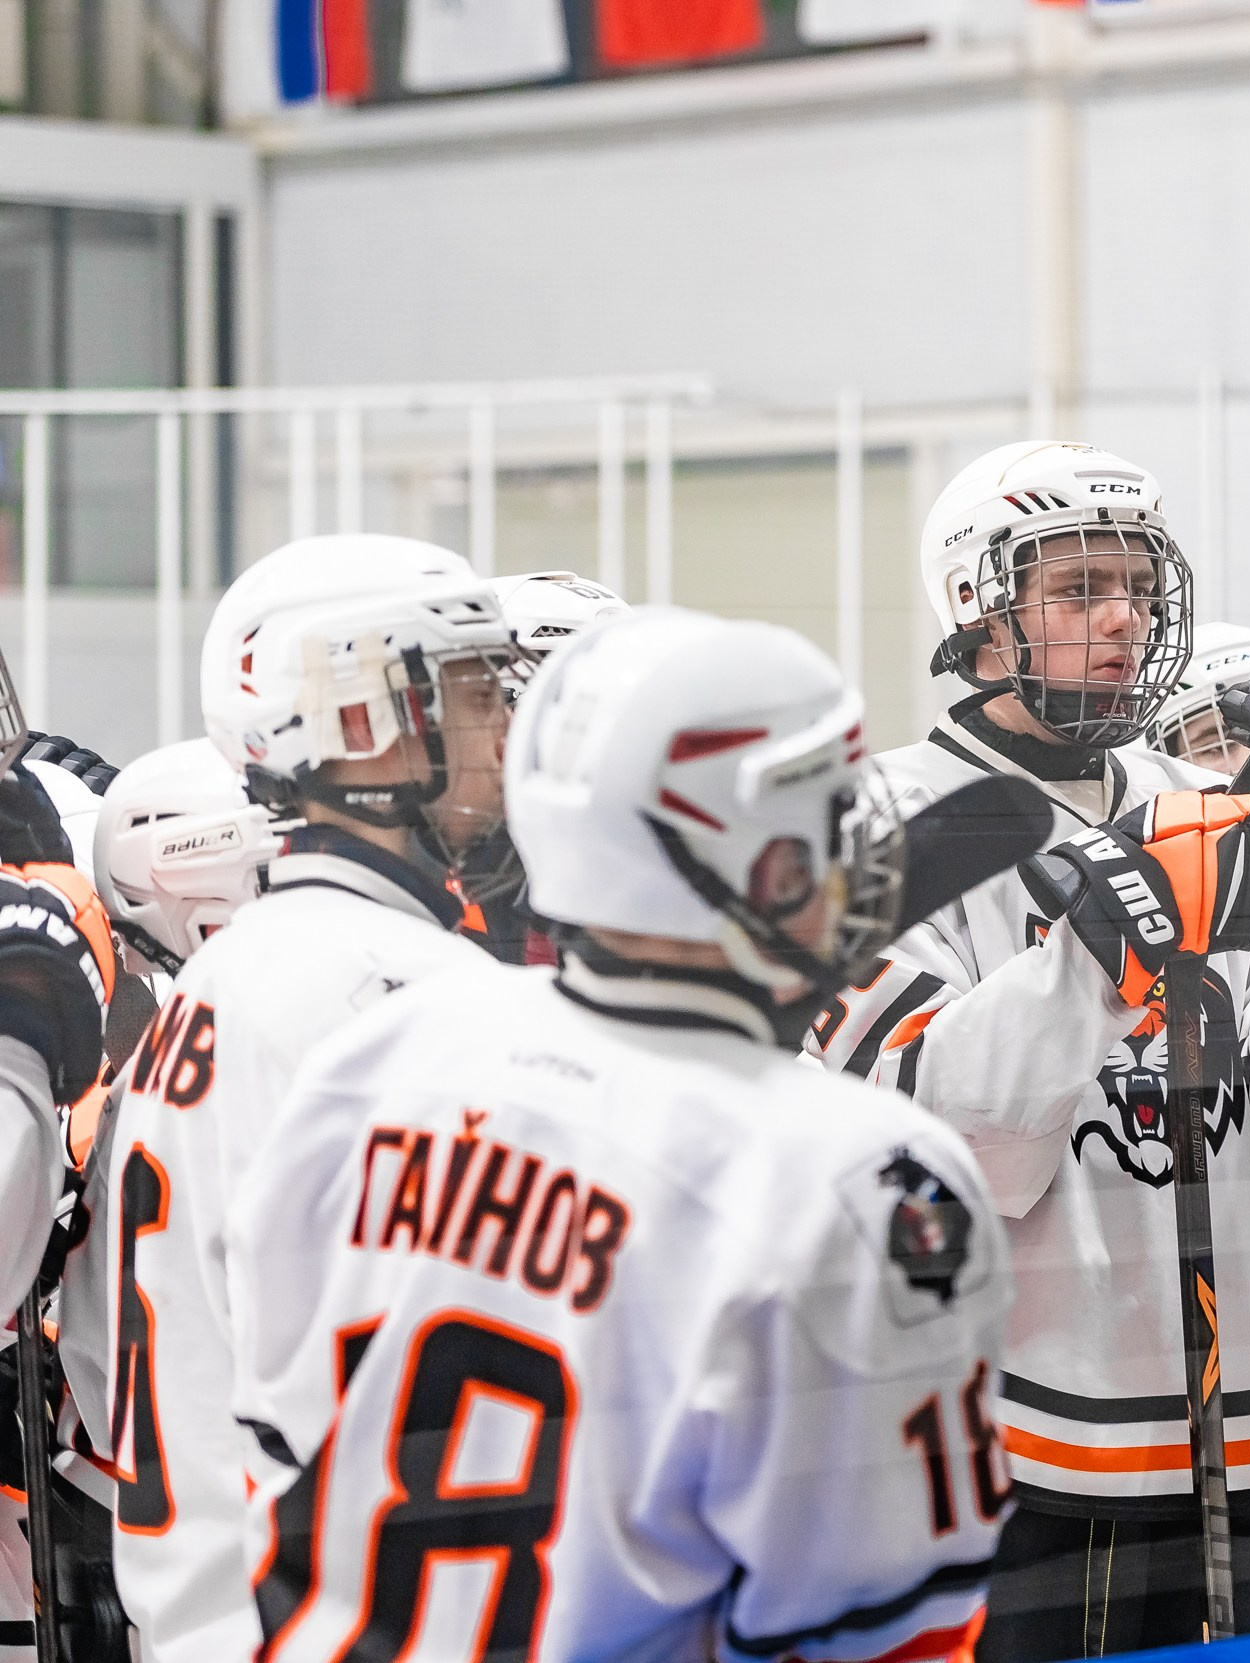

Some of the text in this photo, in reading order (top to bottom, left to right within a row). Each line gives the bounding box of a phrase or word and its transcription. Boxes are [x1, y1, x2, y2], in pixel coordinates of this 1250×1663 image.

[1090, 484, 1141, 496] CCM
[944, 525, 975, 548] CCM
[162, 830, 234, 856] BAUR
[1106, 869, 1175, 945] СШ
